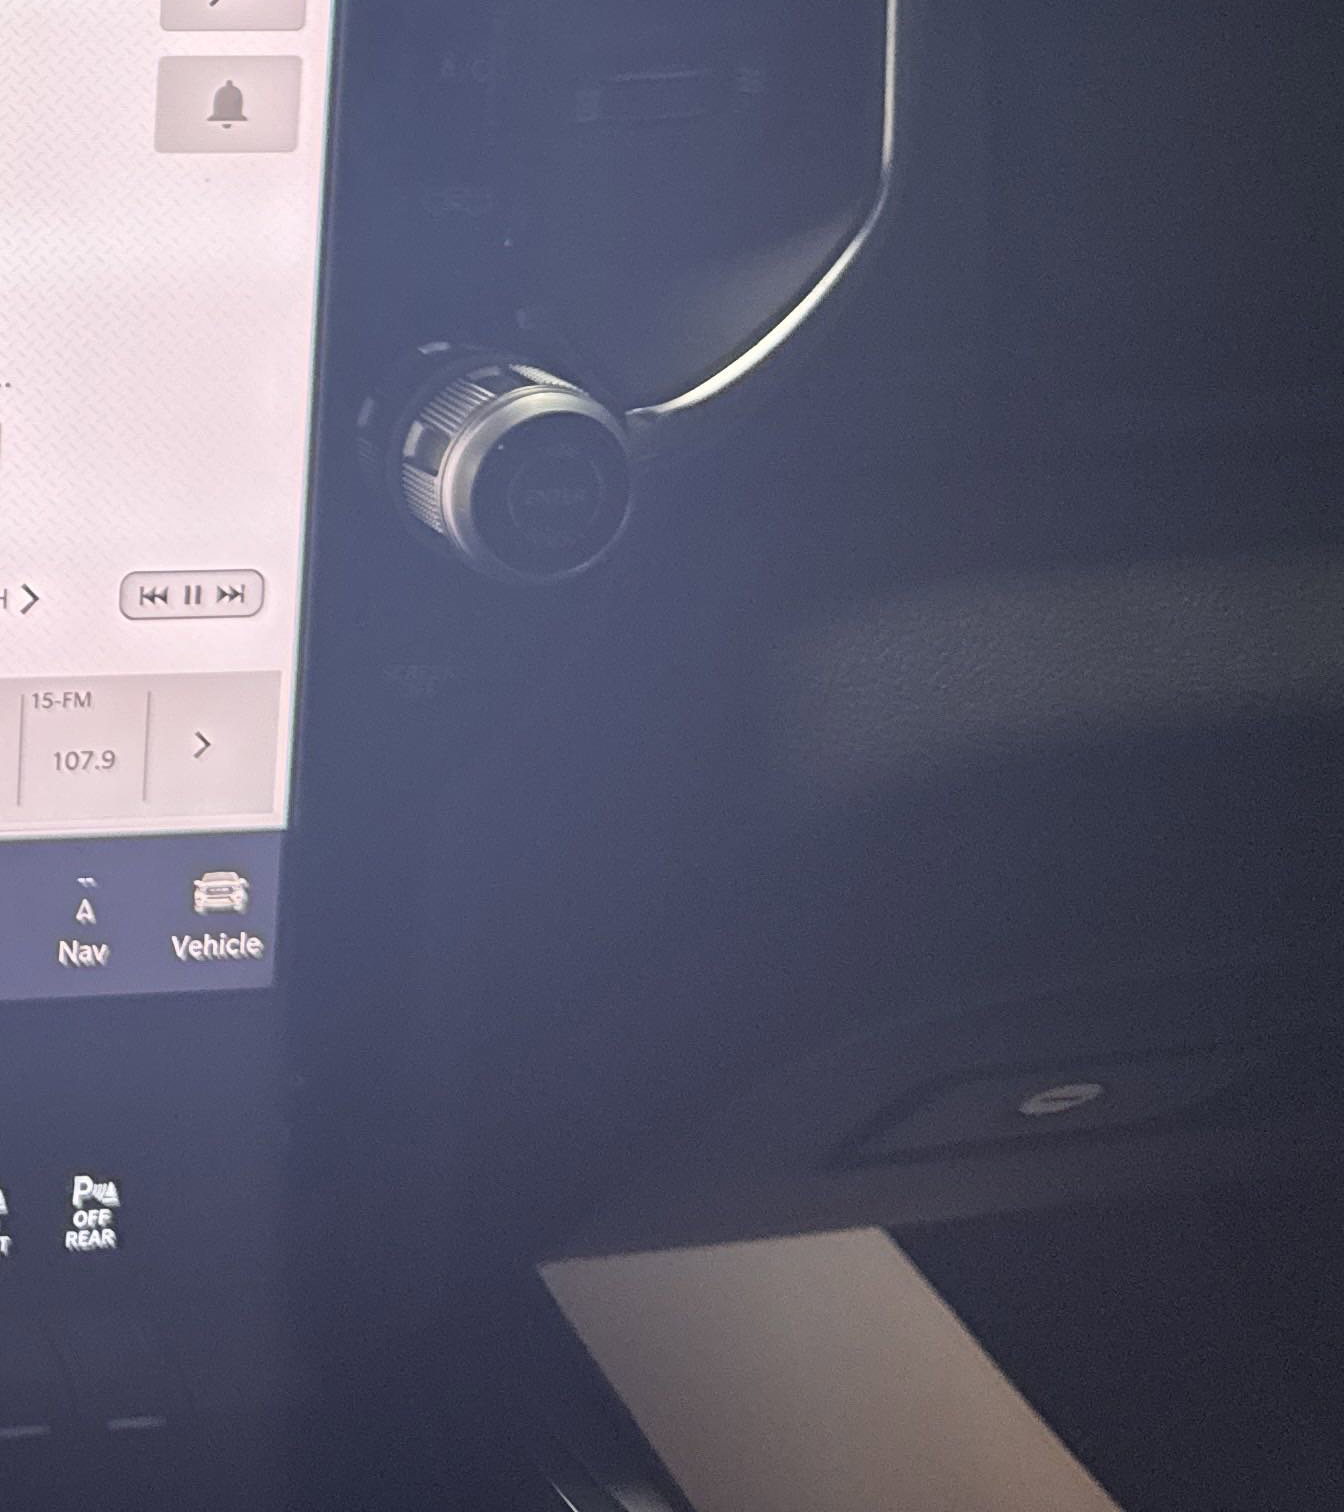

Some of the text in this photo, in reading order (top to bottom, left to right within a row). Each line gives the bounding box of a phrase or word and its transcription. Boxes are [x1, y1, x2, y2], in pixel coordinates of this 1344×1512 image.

[31, 692, 92, 709] 15-FM
[53, 750, 116, 772] 107.9
[57, 939, 110, 967] Nav
[171, 932, 265, 962] Vehicle
[72, 1208, 111, 1229] OFF
[65, 1228, 117, 1251] REAR
